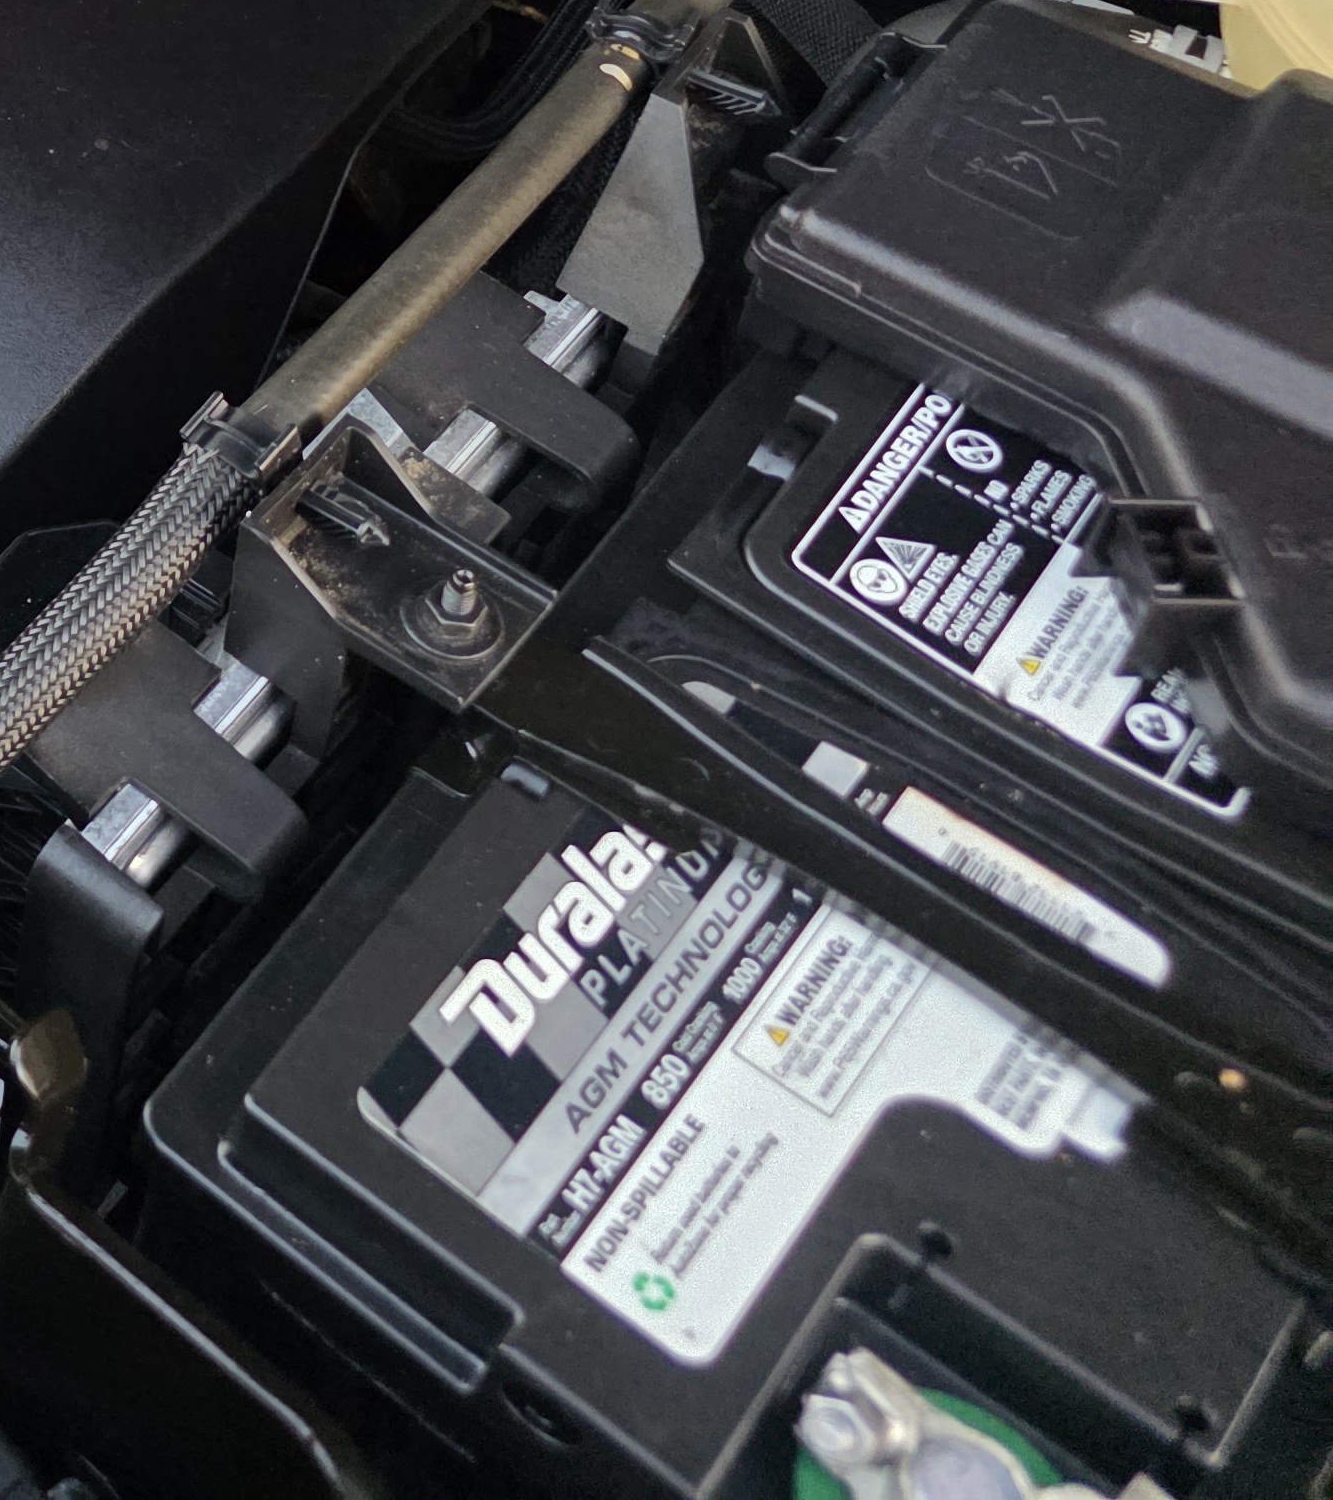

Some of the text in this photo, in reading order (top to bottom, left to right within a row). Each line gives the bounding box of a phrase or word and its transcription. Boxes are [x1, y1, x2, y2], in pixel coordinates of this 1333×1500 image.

[850, 389, 957, 517] DANGER/PO
[982, 475, 1012, 505] NO
[1010, 458, 1052, 505] SPARKS
[1031, 468, 1072, 516] FLAMES
[1050, 473, 1097, 528] SMOKING
[898, 550, 961, 623] SHIELD EYES.
[921, 517, 1015, 634] EXPLOSIVE GASES CAN
[941, 540, 1024, 645] CAUSE BLINDNESS
[960, 589, 1016, 657] OR INJURY.
[1025, 581, 1090, 661] WARNING:
[717, 951, 768, 1006] 1000
[773, 930, 856, 1029] WARNING:
[562, 1045, 629, 1135] AGM
[556, 1047, 695, 1216] H7-AGM 850
[580, 1112, 707, 1274] NON-SPILLABLE
